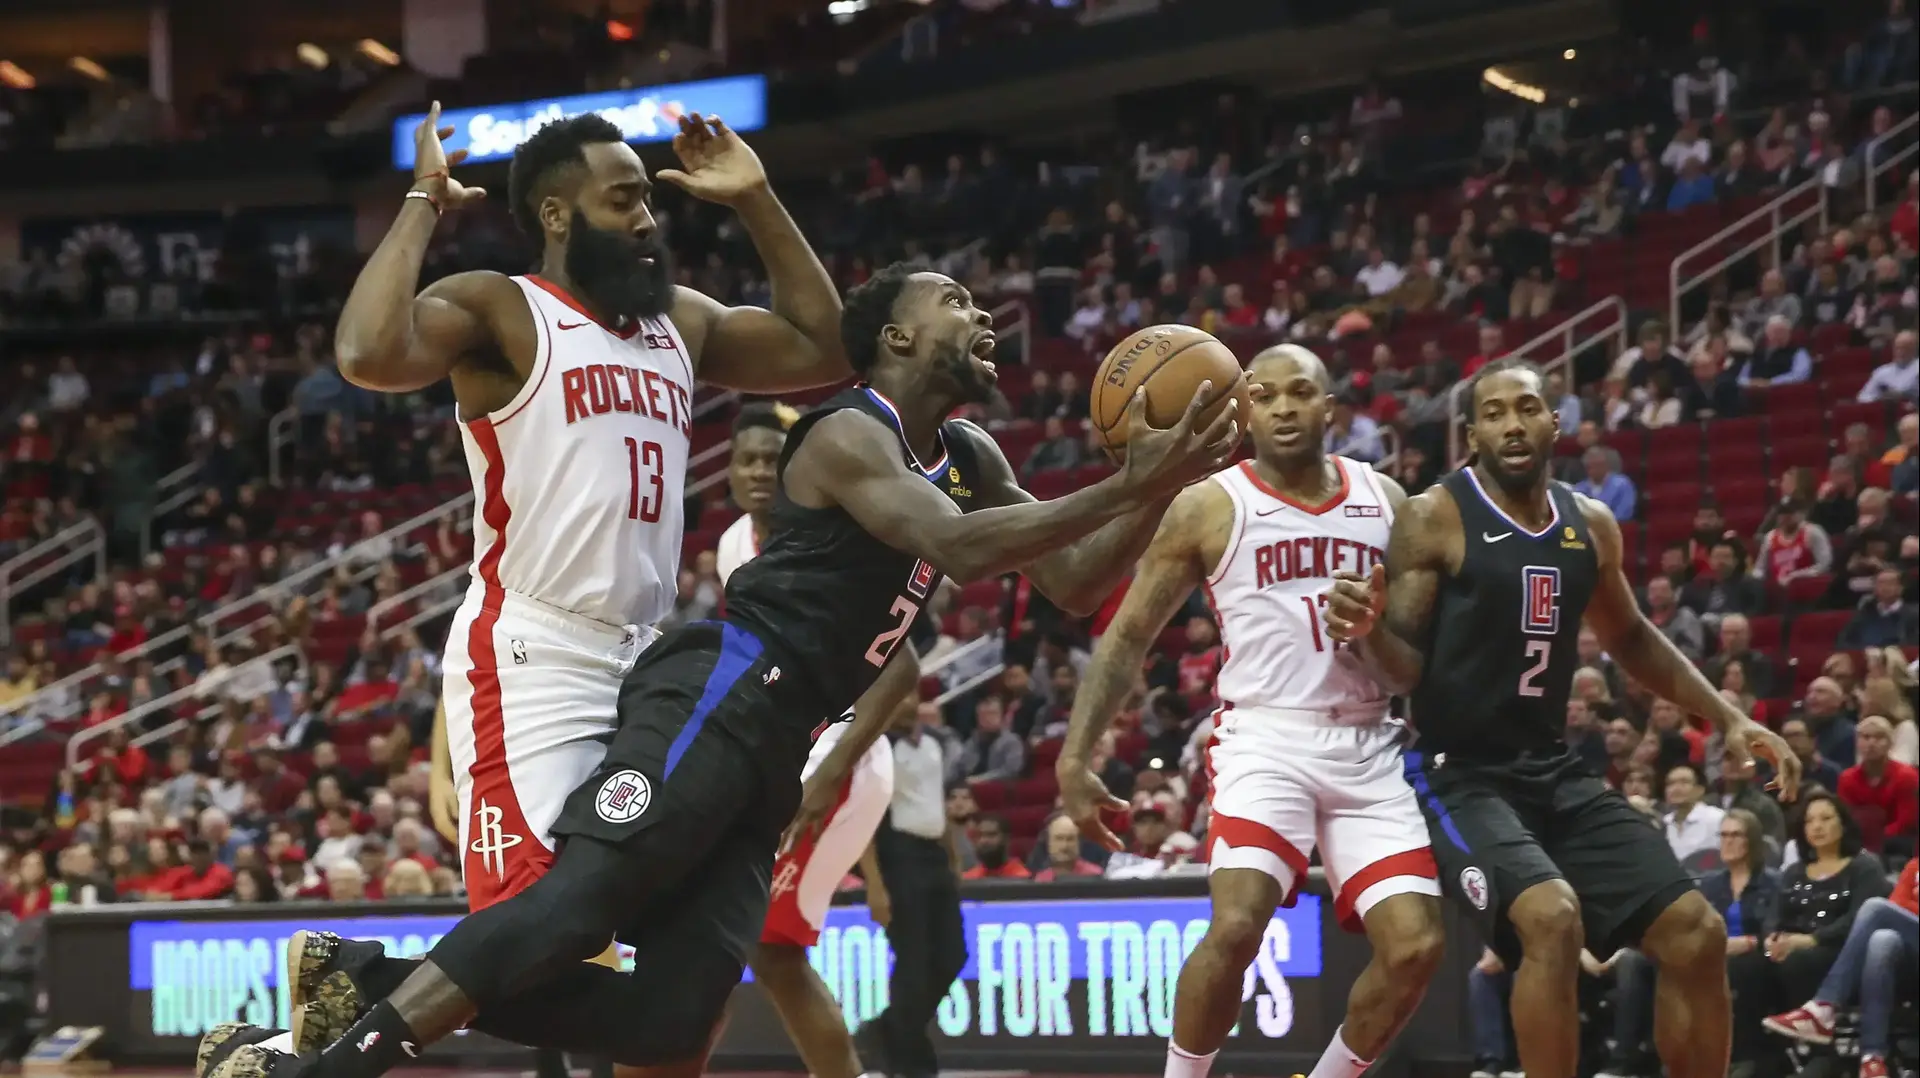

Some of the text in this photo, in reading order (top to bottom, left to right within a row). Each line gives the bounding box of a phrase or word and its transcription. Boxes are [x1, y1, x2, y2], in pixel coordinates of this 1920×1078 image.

[562, 364, 692, 440] ROCKETS
[624, 437, 664, 523] 13
[864, 595, 920, 668] 2
[1518, 640, 1551, 696] 2
[151, 938, 274, 1036] HOOPS
[807, 918, 1294, 1038] HOS FOR TROS
